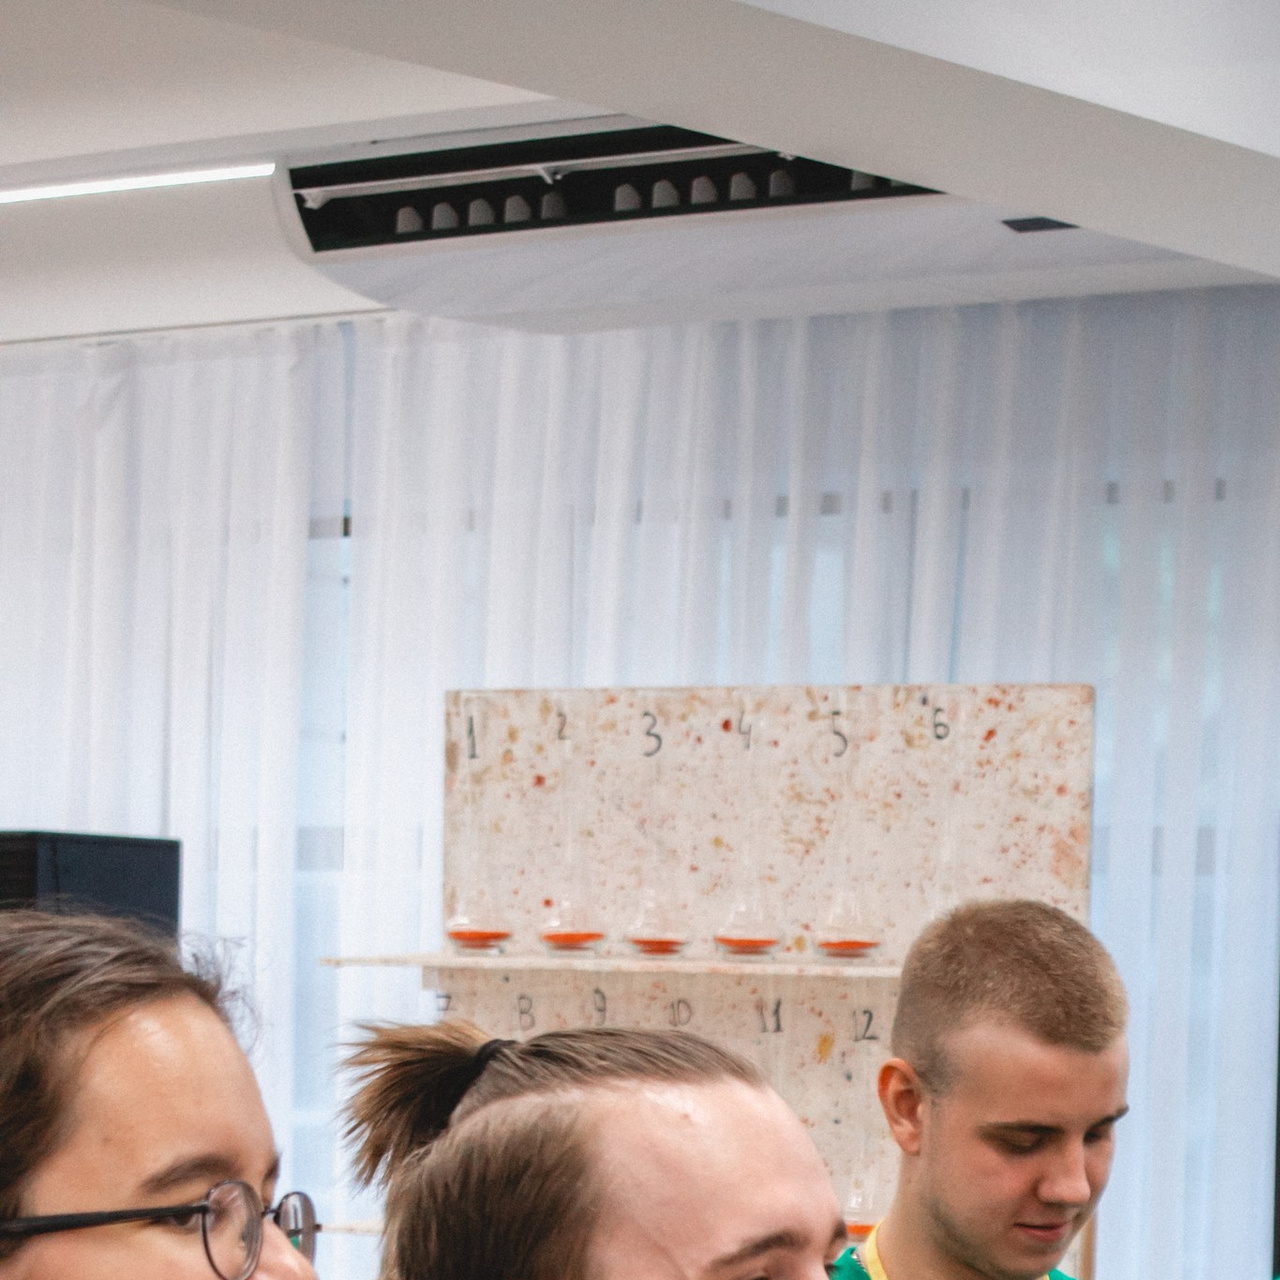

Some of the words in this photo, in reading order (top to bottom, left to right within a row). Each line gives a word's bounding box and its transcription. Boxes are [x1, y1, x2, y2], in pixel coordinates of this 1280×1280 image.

[467, 714, 479, 760] 1
[557, 707, 568, 741] 2
[642, 710, 663, 758] 3
[738, 709, 752, 751] 4
[830, 709, 848, 758] 5
[933, 706, 950, 740] 6
[668, 998, 694, 1028] 10
[756, 997, 783, 1034] 11
[852, 1008, 879, 1043] 12
